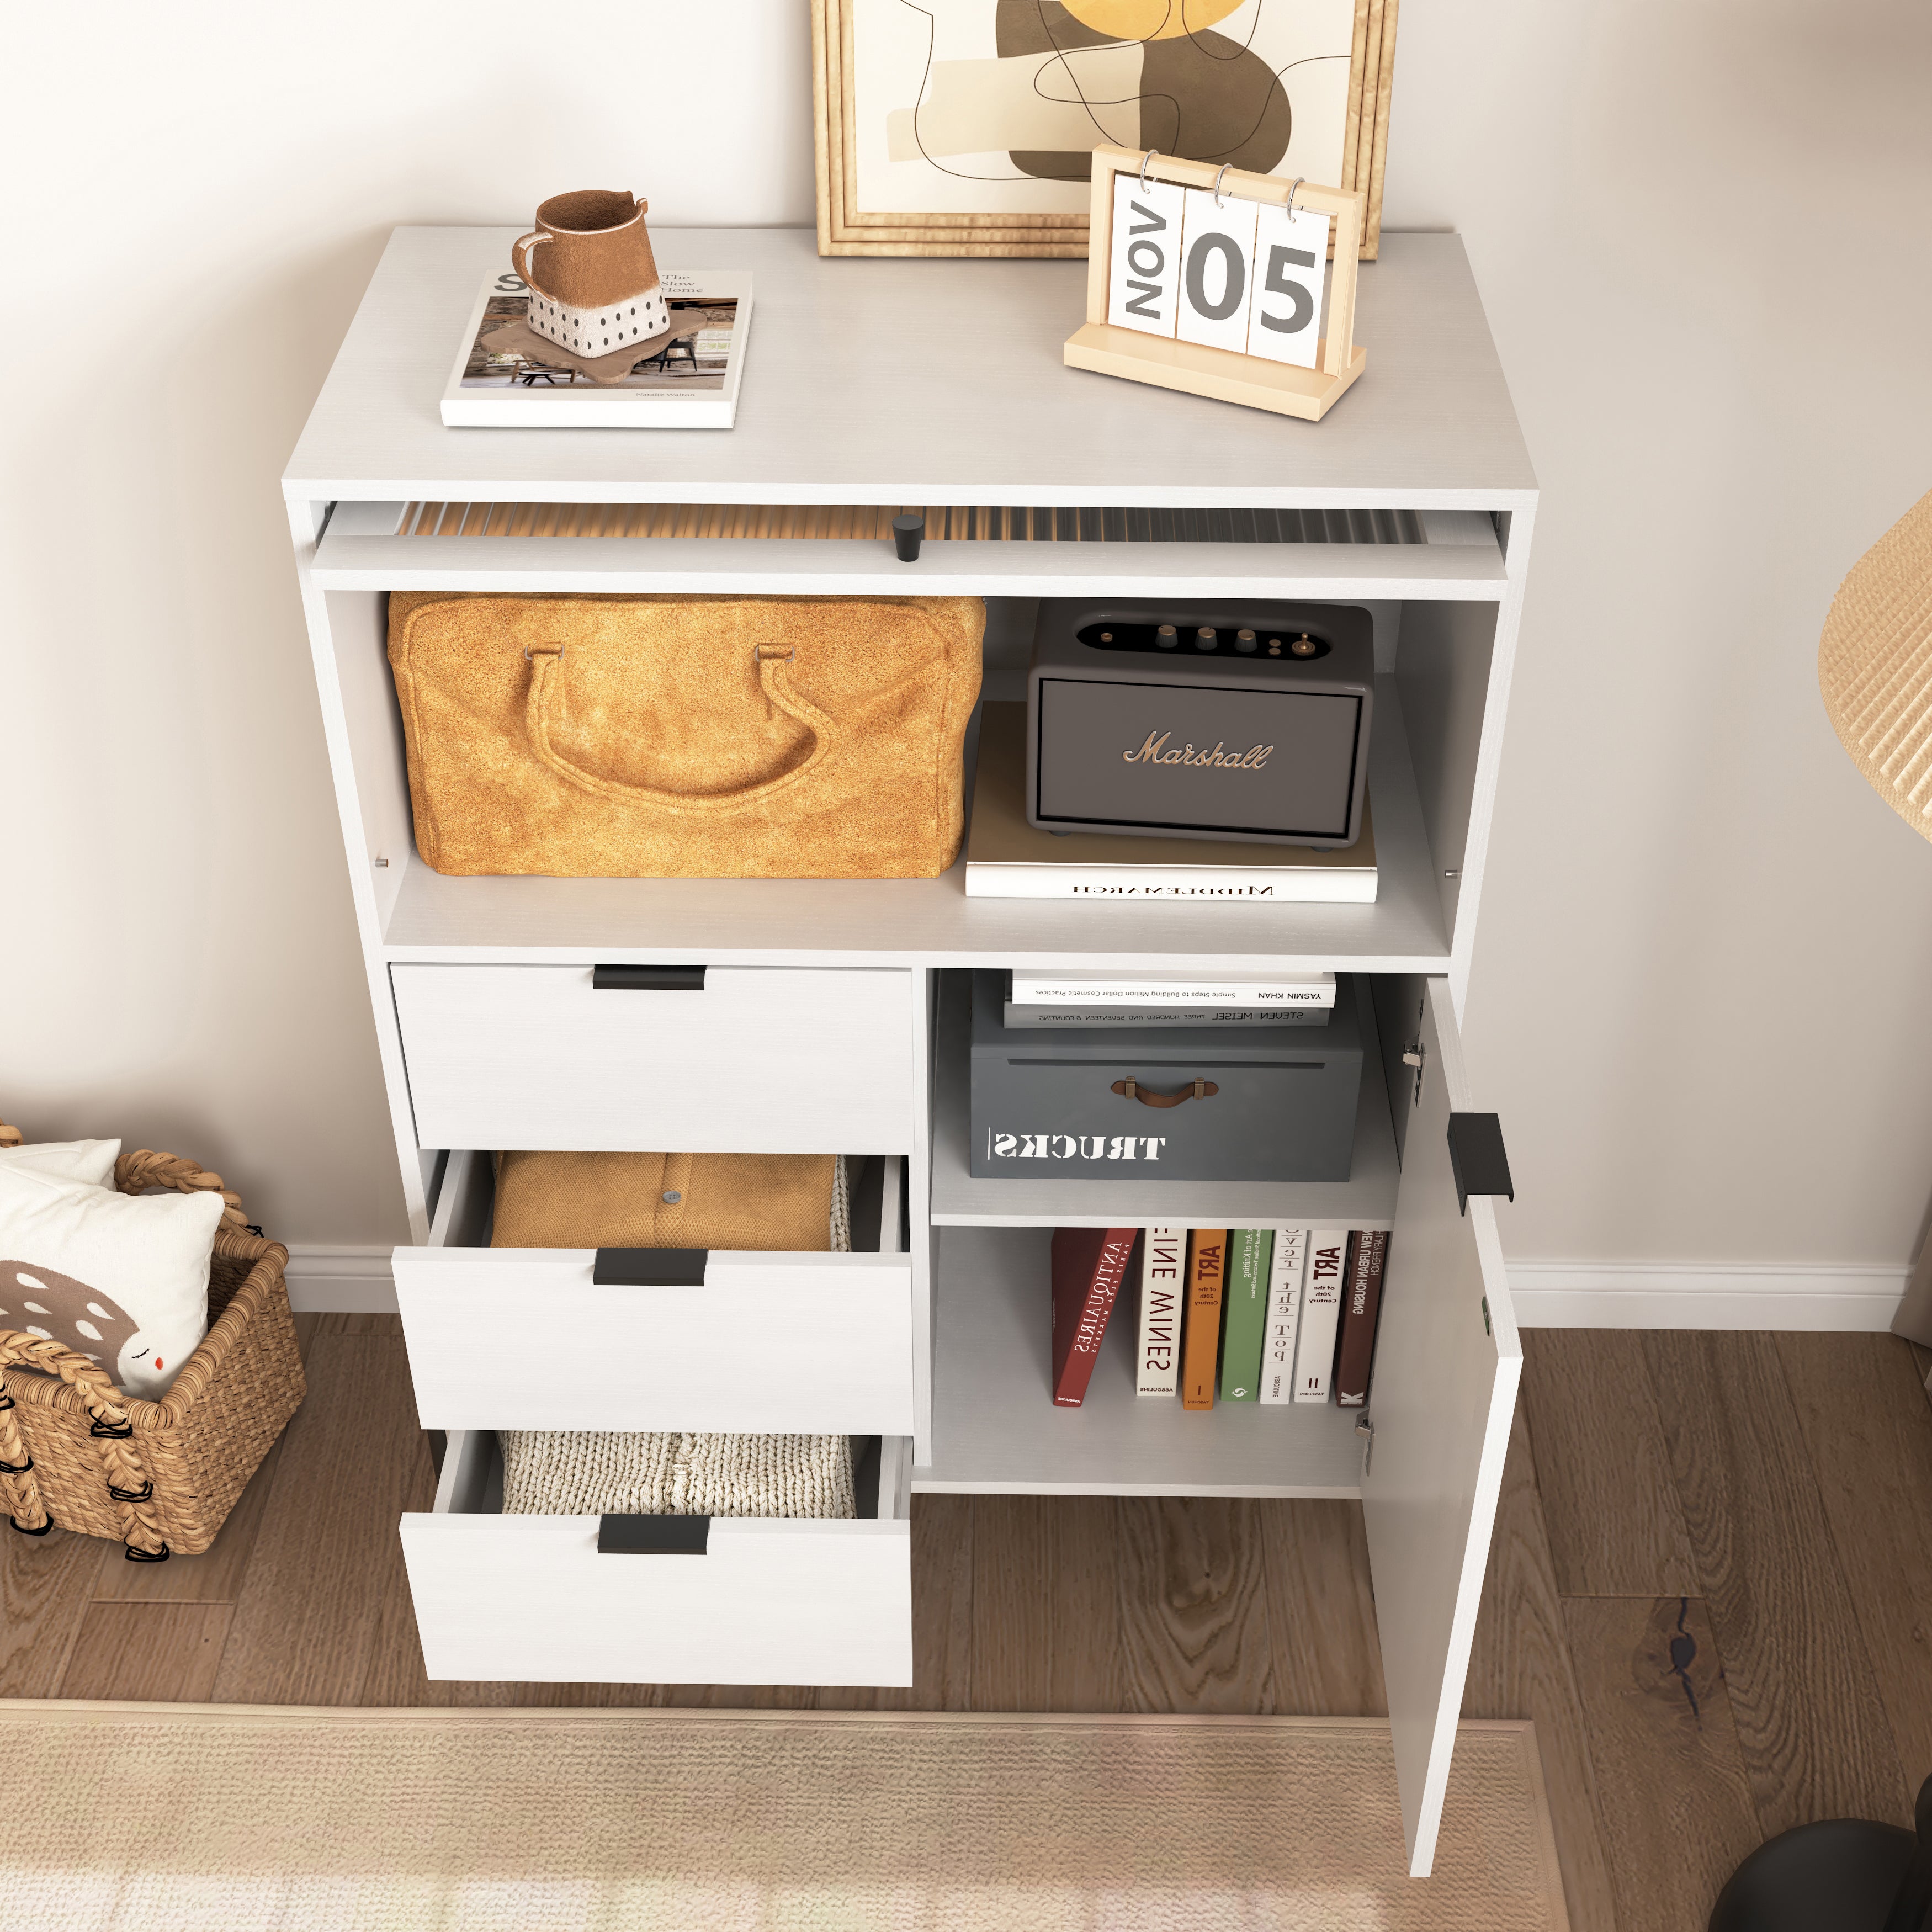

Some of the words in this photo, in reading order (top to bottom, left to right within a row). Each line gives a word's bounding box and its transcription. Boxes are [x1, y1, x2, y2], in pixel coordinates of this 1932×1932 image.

[1125, 200, 1167, 320] NOV
[1186, 232, 1316, 333] 05
[1122, 730, 1274, 770] Marshall
